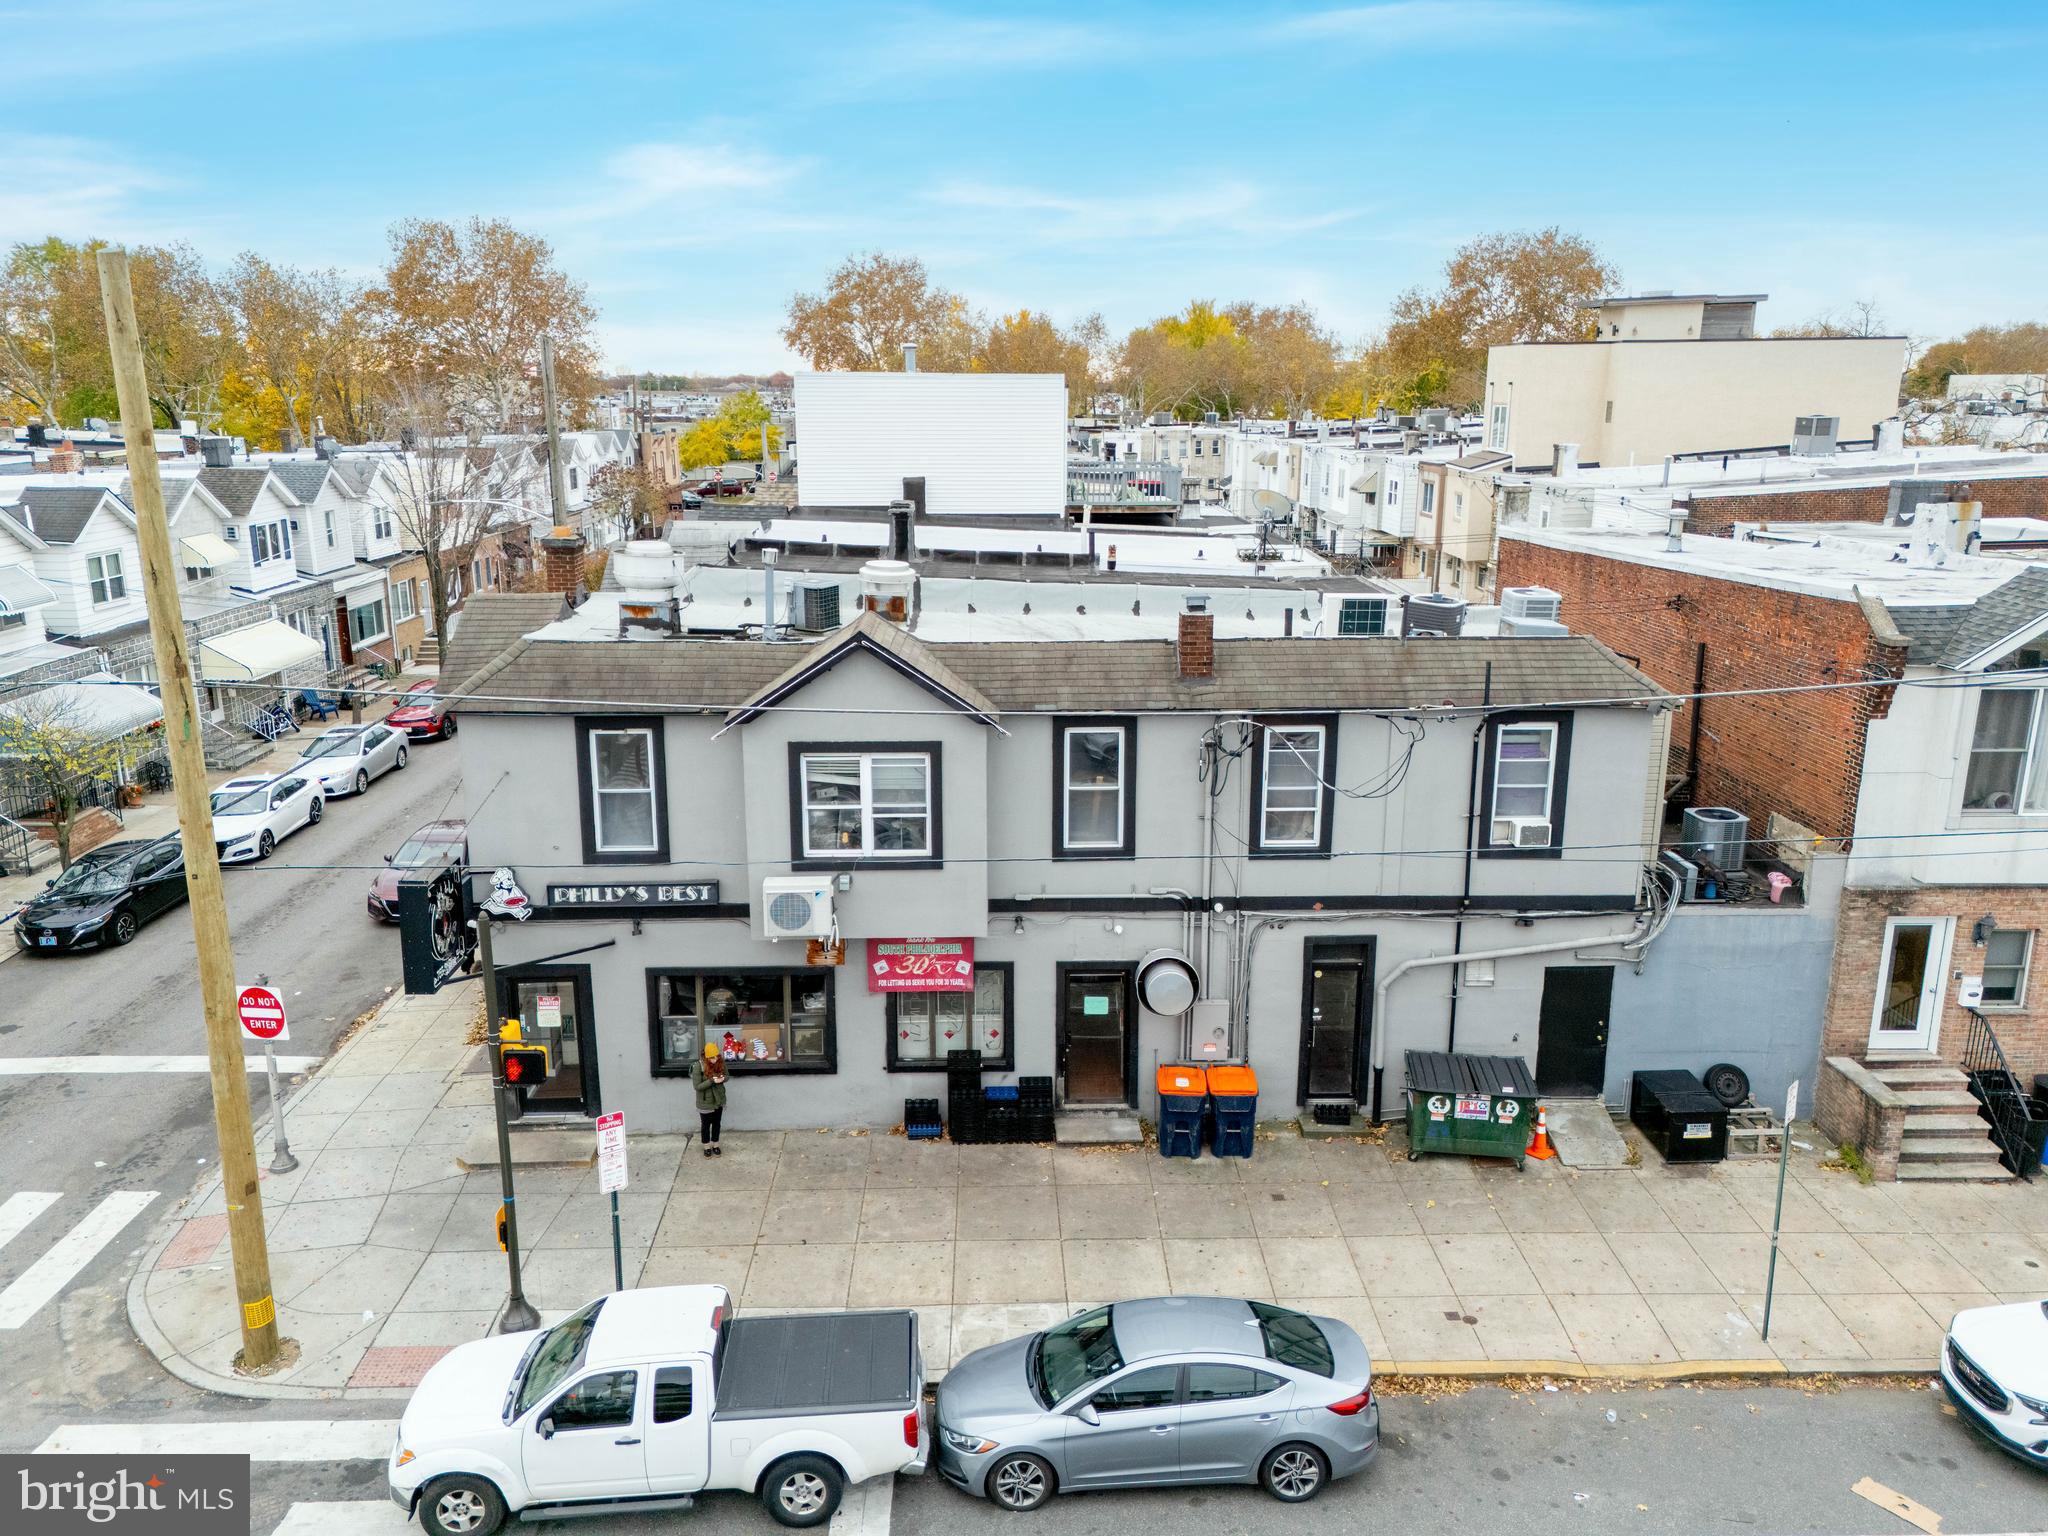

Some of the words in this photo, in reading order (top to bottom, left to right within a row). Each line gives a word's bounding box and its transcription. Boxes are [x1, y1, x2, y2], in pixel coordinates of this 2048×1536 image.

[554, 886, 649, 902] PHILLY'S
[658, 885, 711, 901] BEST
[878, 944, 905, 955] SOUTH
[906, 943, 962, 954] PHILADELPHIA
[242, 997, 255, 1006] DO
[257, 997, 275, 1006] NOT
[249, 1020, 277, 1030] ENTER
[599, 1120, 622, 1130] STOPPING
[605, 1129, 617, 1137] ANY
[1959, 1360, 1980, 1385] GMC
